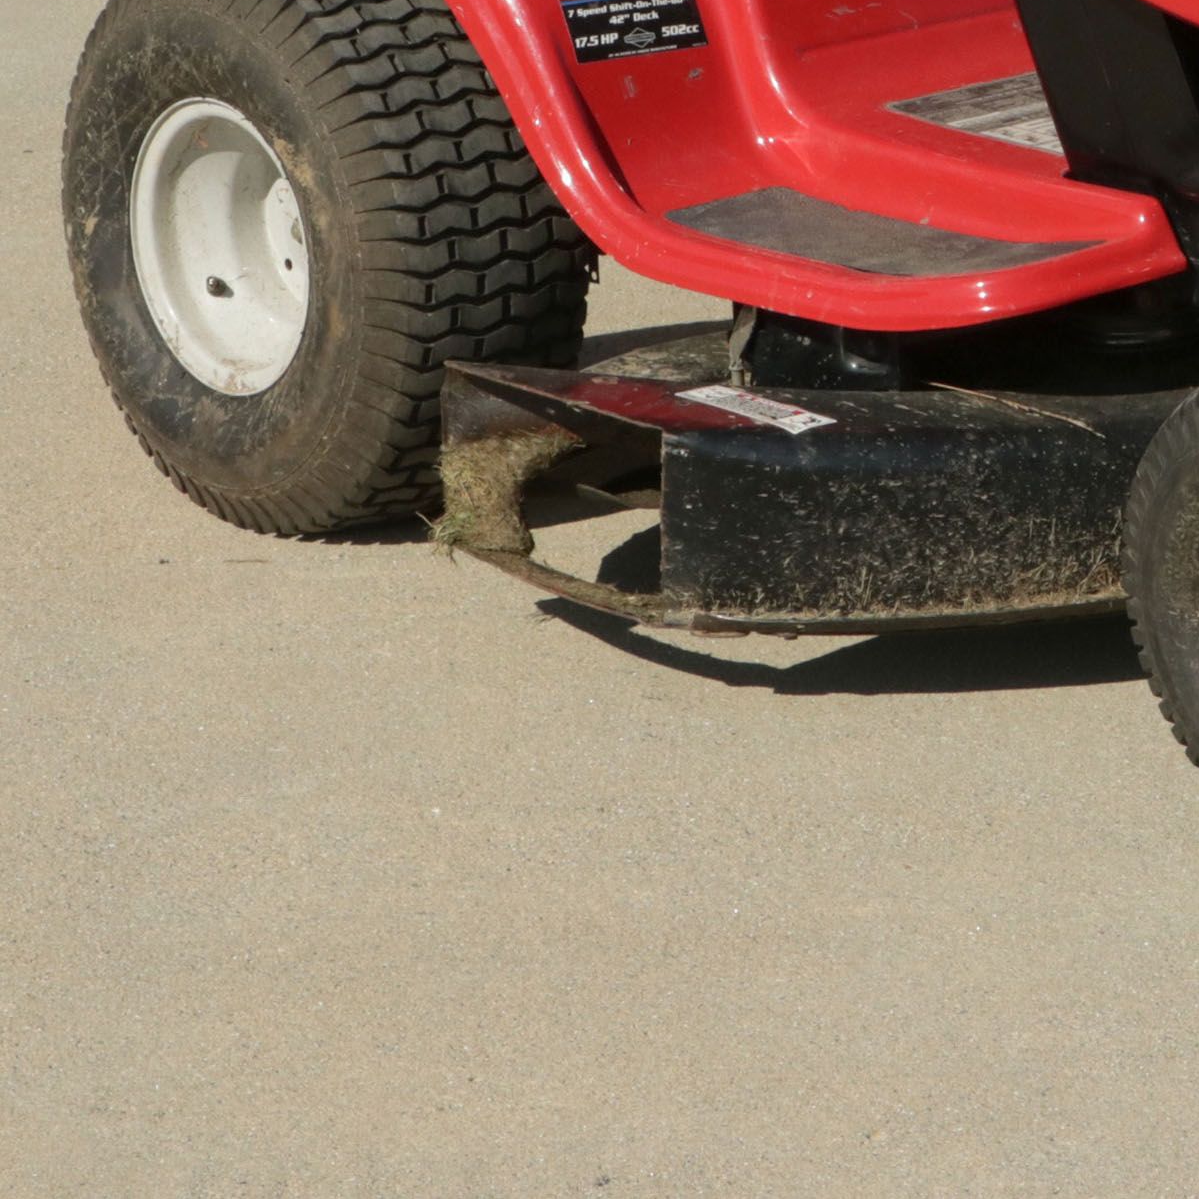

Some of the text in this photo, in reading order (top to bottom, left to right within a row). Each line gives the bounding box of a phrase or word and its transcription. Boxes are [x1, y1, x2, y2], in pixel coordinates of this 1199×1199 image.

[568, 9, 575, 18] 7
[576, 5, 608, 18] Speed
[633, 10, 660, 22] Deck
[661, 24, 700, 37] 502cc
[574, 35, 599, 49] 17.5
[600, 32, 619, 45] HP
